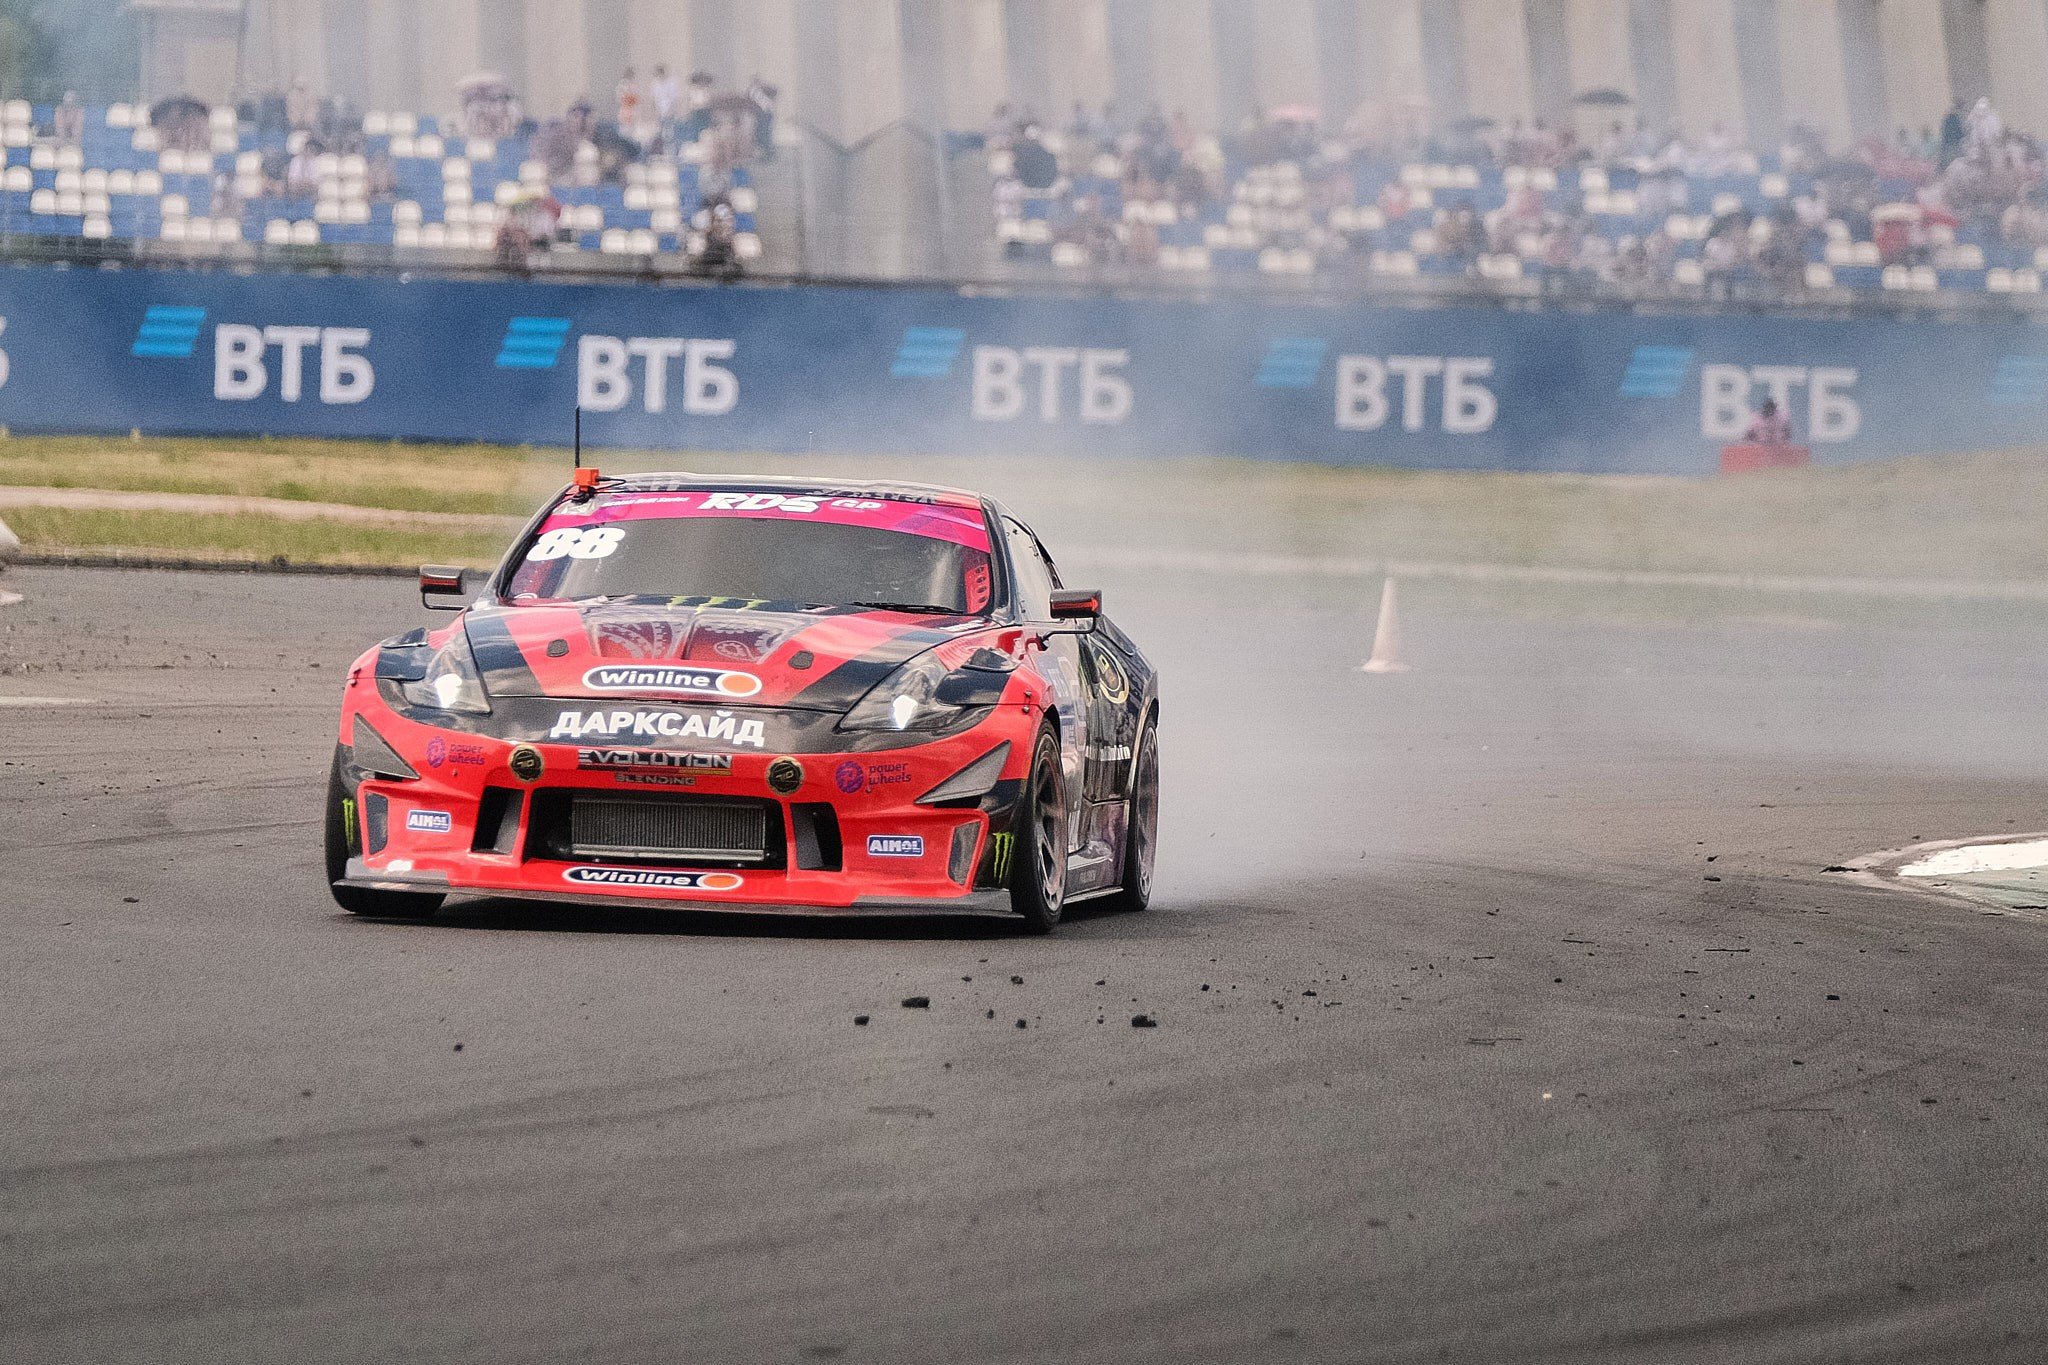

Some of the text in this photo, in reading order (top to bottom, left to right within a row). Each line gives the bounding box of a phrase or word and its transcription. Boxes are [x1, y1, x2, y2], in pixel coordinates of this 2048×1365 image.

[214, 323, 374, 403] ВТБ
[577, 335, 739, 414] ВТБ
[972, 345, 1133, 423] ВТБ
[1335, 354, 1498, 433] ВТБ
[1701, 364, 1861, 443] ВТБ
[697, 493, 832, 513] RDS
[831, 500, 882, 509] GP
[527, 527, 626, 561] 88
[550, 710, 765, 747] ДАРКСАЙД
[449, 753, 485, 765] wheels
[450, 744, 484, 754] power
[578, 750, 733, 768] EVOLUTION
[615, 772, 696, 785] BLENDING
[868, 763, 908, 774] power
[868, 772, 912, 785] wheels
[868, 839, 921, 853] AIMOL
